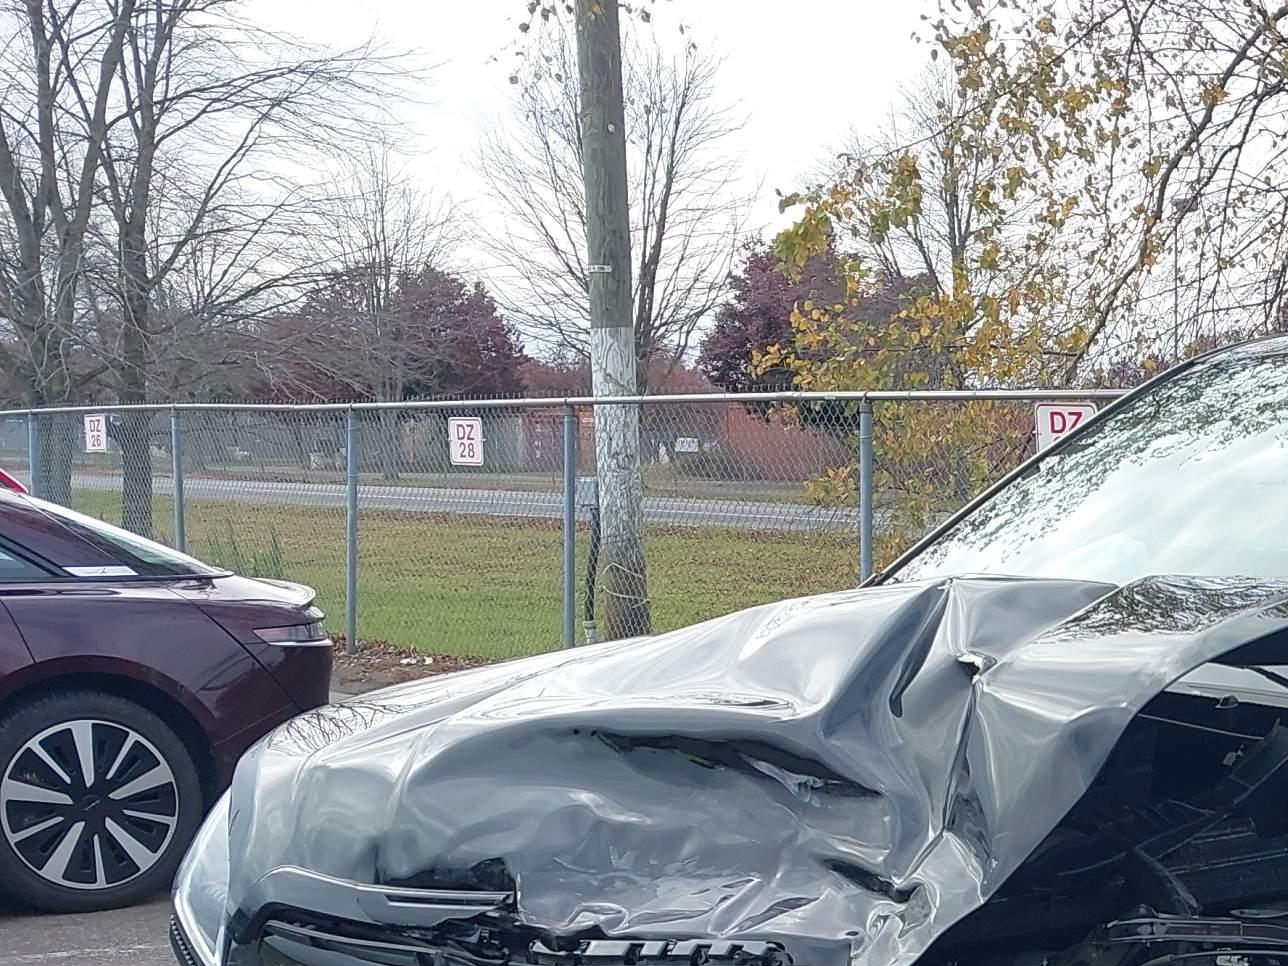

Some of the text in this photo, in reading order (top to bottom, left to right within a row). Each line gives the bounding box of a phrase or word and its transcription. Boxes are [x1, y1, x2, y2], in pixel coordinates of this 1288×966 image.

[89, 419, 102, 432] DZ
[456, 424, 475, 440] DZ
[91, 434, 102, 447] 26
[459, 442, 475, 458] 28
